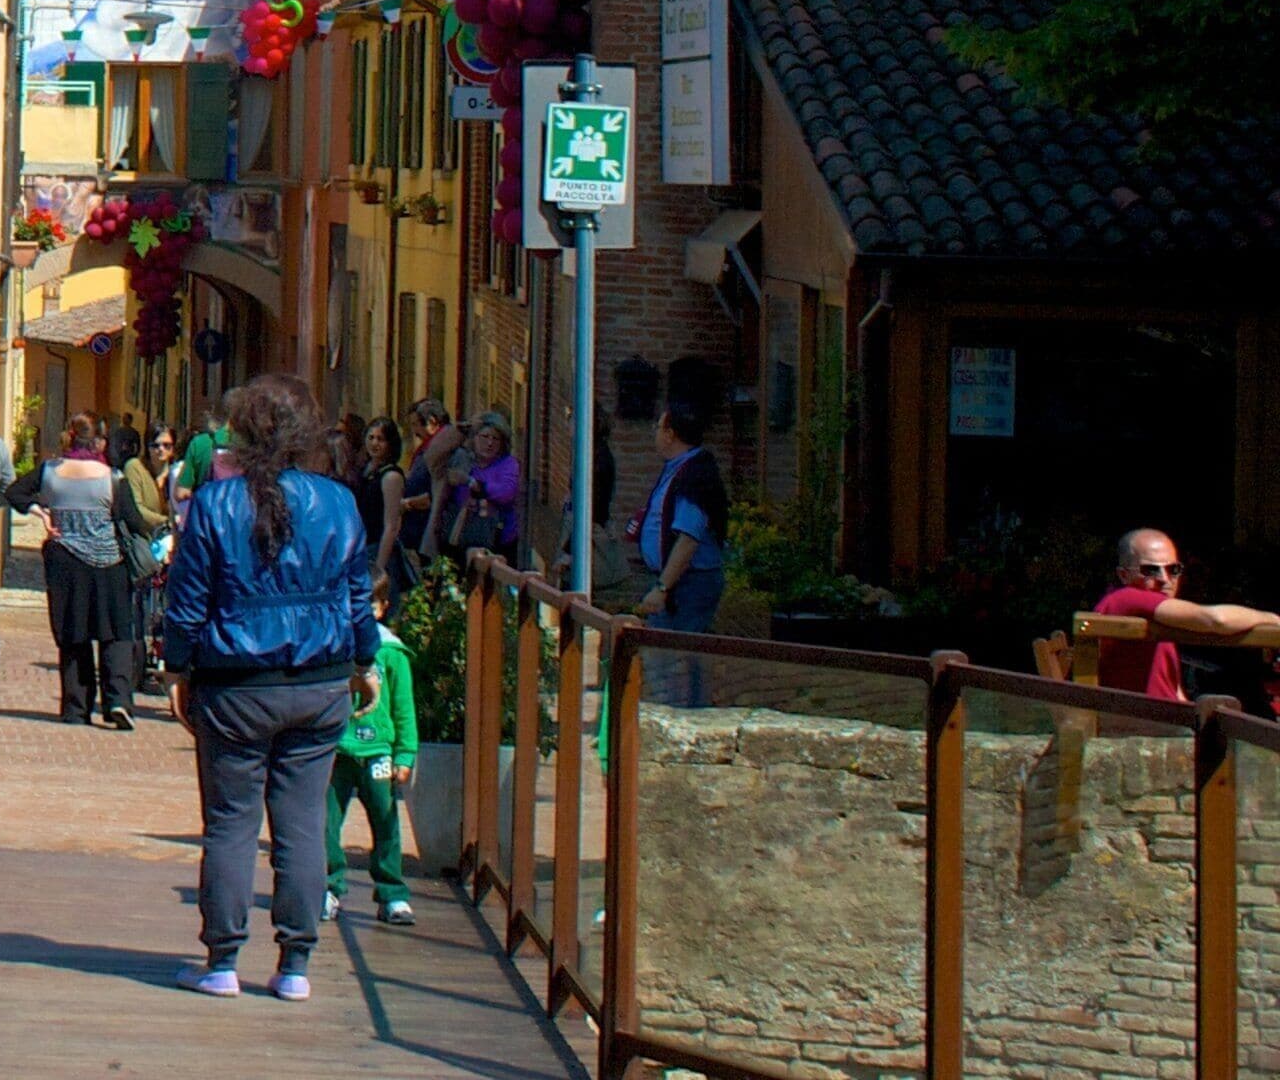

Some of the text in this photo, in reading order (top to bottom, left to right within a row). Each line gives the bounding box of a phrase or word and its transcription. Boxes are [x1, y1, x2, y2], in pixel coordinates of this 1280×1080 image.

[559, 182, 612, 192] PUNTO DI
[555, 191, 615, 201] RACCOLTA
